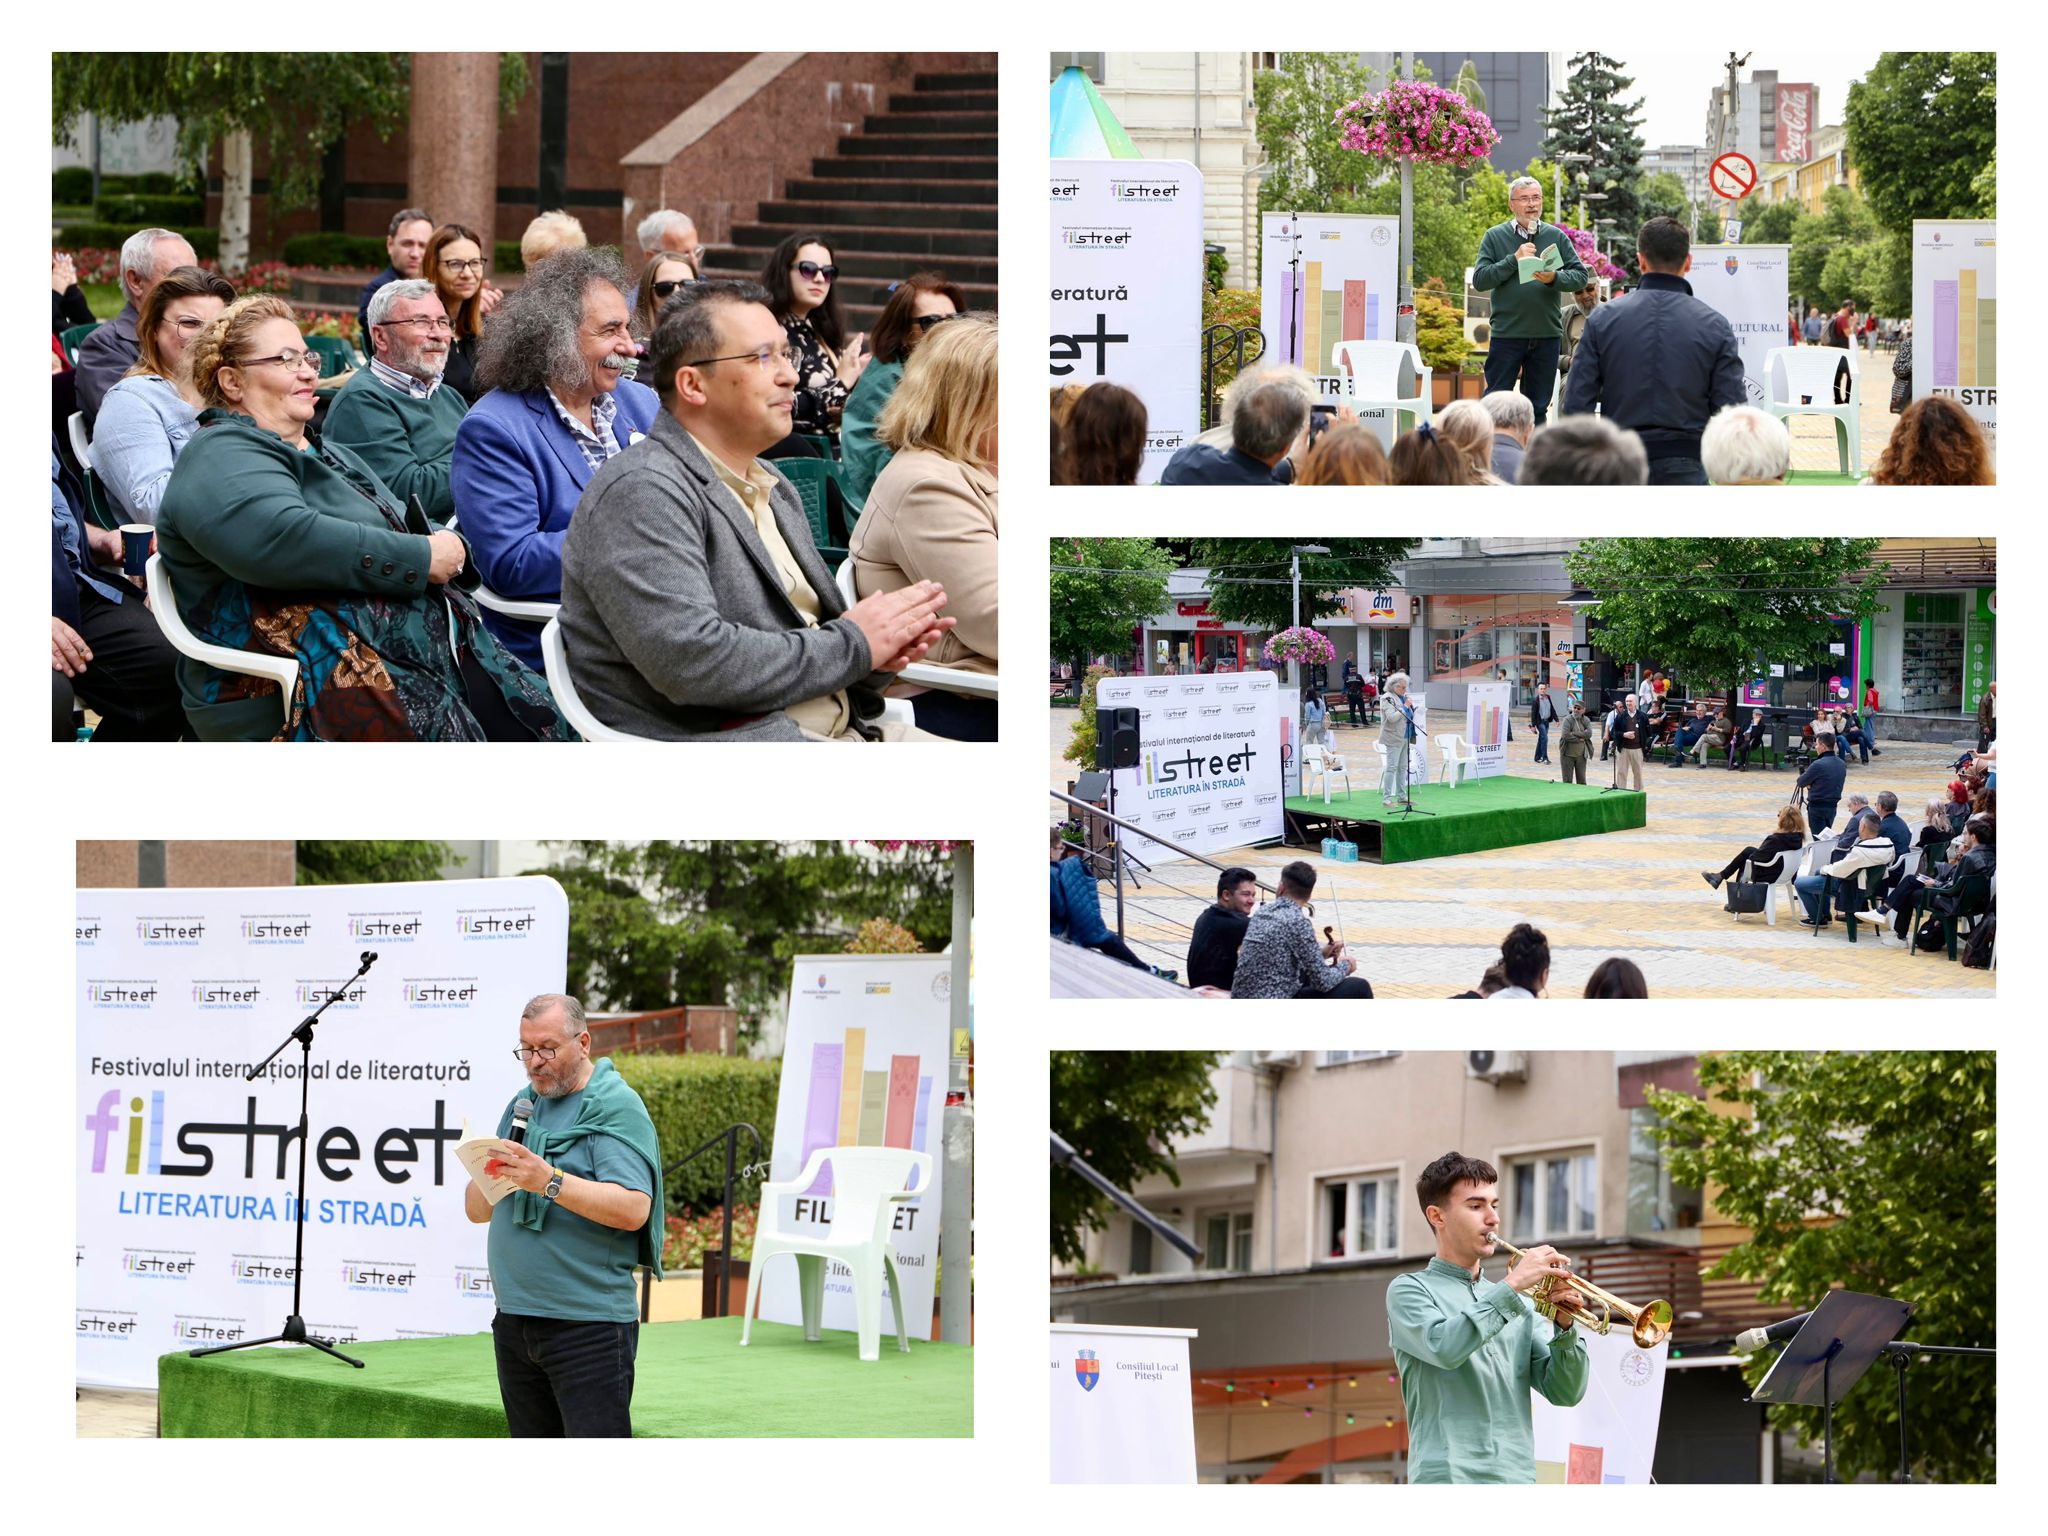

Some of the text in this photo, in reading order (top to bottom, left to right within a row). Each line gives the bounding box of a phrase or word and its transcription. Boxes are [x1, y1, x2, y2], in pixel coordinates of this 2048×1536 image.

[1110, 184, 1179, 197] filstreet
[1062, 231, 1131, 244] filstreet
[1051, 285, 1128, 301] eratură
[1729, 323, 1784, 333] ULTURAL
[1373, 588, 1393, 609] dm
[1557, 641, 1571, 651] dm
[1139, 729, 1255, 748] stivalul internațional de literatură
[1133, 743, 1257, 786] filstreet
[1147, 776, 1246, 800] LITERATURA ÎN STRADĂ
[136, 922, 205, 939] filstreet
[241, 921, 311, 938] filstreet
[348, 918, 422, 936] filstreet
[456, 914, 535, 933] filstreet
[87, 985, 157, 1002] filstreet
[192, 986, 260, 1002] filstreet
[403, 984, 478, 1001] filstreet
[91, 1057, 471, 1085] Festivalul internațional de literatură
[85, 1089, 463, 1187] filstreet
[118, 1191, 427, 1229] LITERATURA ÎN STRADĂ
[122, 1253, 195, 1273] filstreet
[341, 1266, 416, 1286] filstreet
[172, 1321, 245, 1340] filstreet
[1116, 1361, 1179, 1372] Consiliul Local
[1134, 1371, 1163, 1381] Pitești
